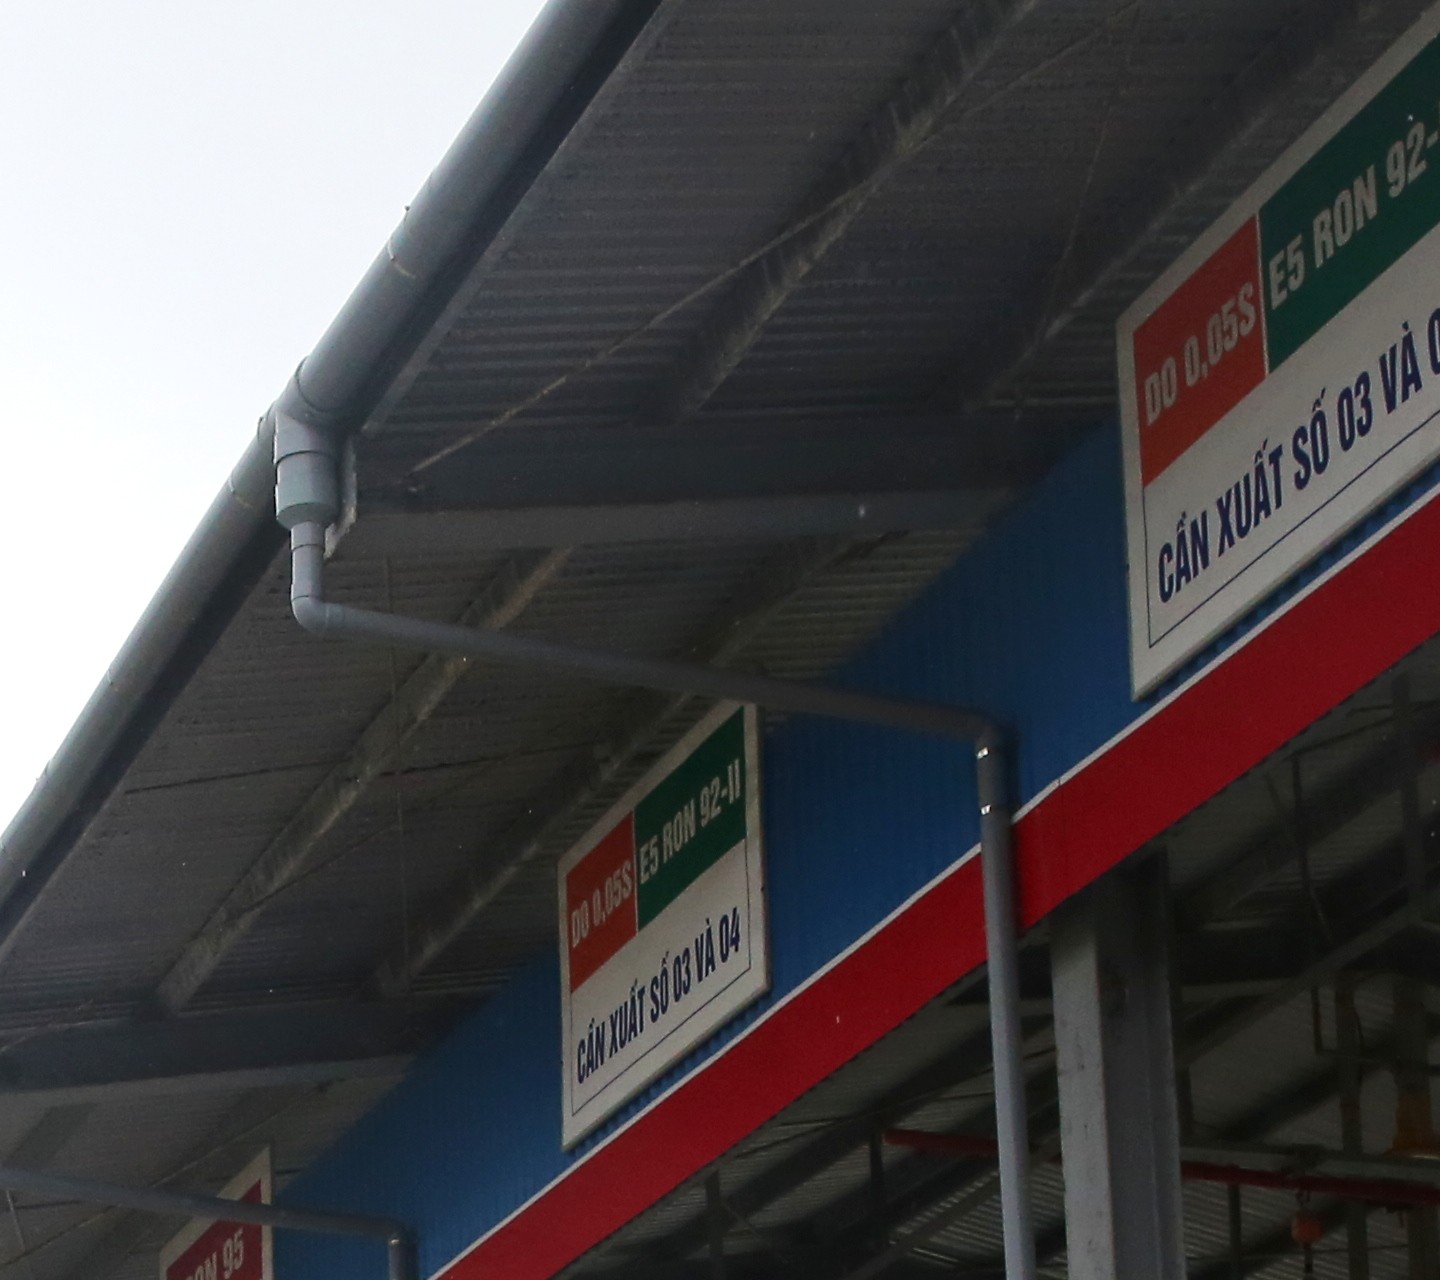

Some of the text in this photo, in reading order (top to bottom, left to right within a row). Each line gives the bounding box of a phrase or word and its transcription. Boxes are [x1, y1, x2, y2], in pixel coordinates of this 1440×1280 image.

[1268, 234, 1307, 310] E5
[1312, 165, 1379, 270] RON
[1144, 282, 1257, 426] DO 0,05S
[1157, 510, 1210, 604] CẦN
[1217, 438, 1286, 560] XUẤT
[1292, 386, 1331, 492] SỐ
[1336, 367, 1374, 453] 03
[1378, 319, 1424, 416] VÀ
[638, 757, 742, 885] E5 RON 92-II
[570, 908, 590, 948] DO
[576, 906, 741, 1085] CẦN XUẤT SỐ 03 VÀ 04
[221, 1228, 245, 1280] 95
